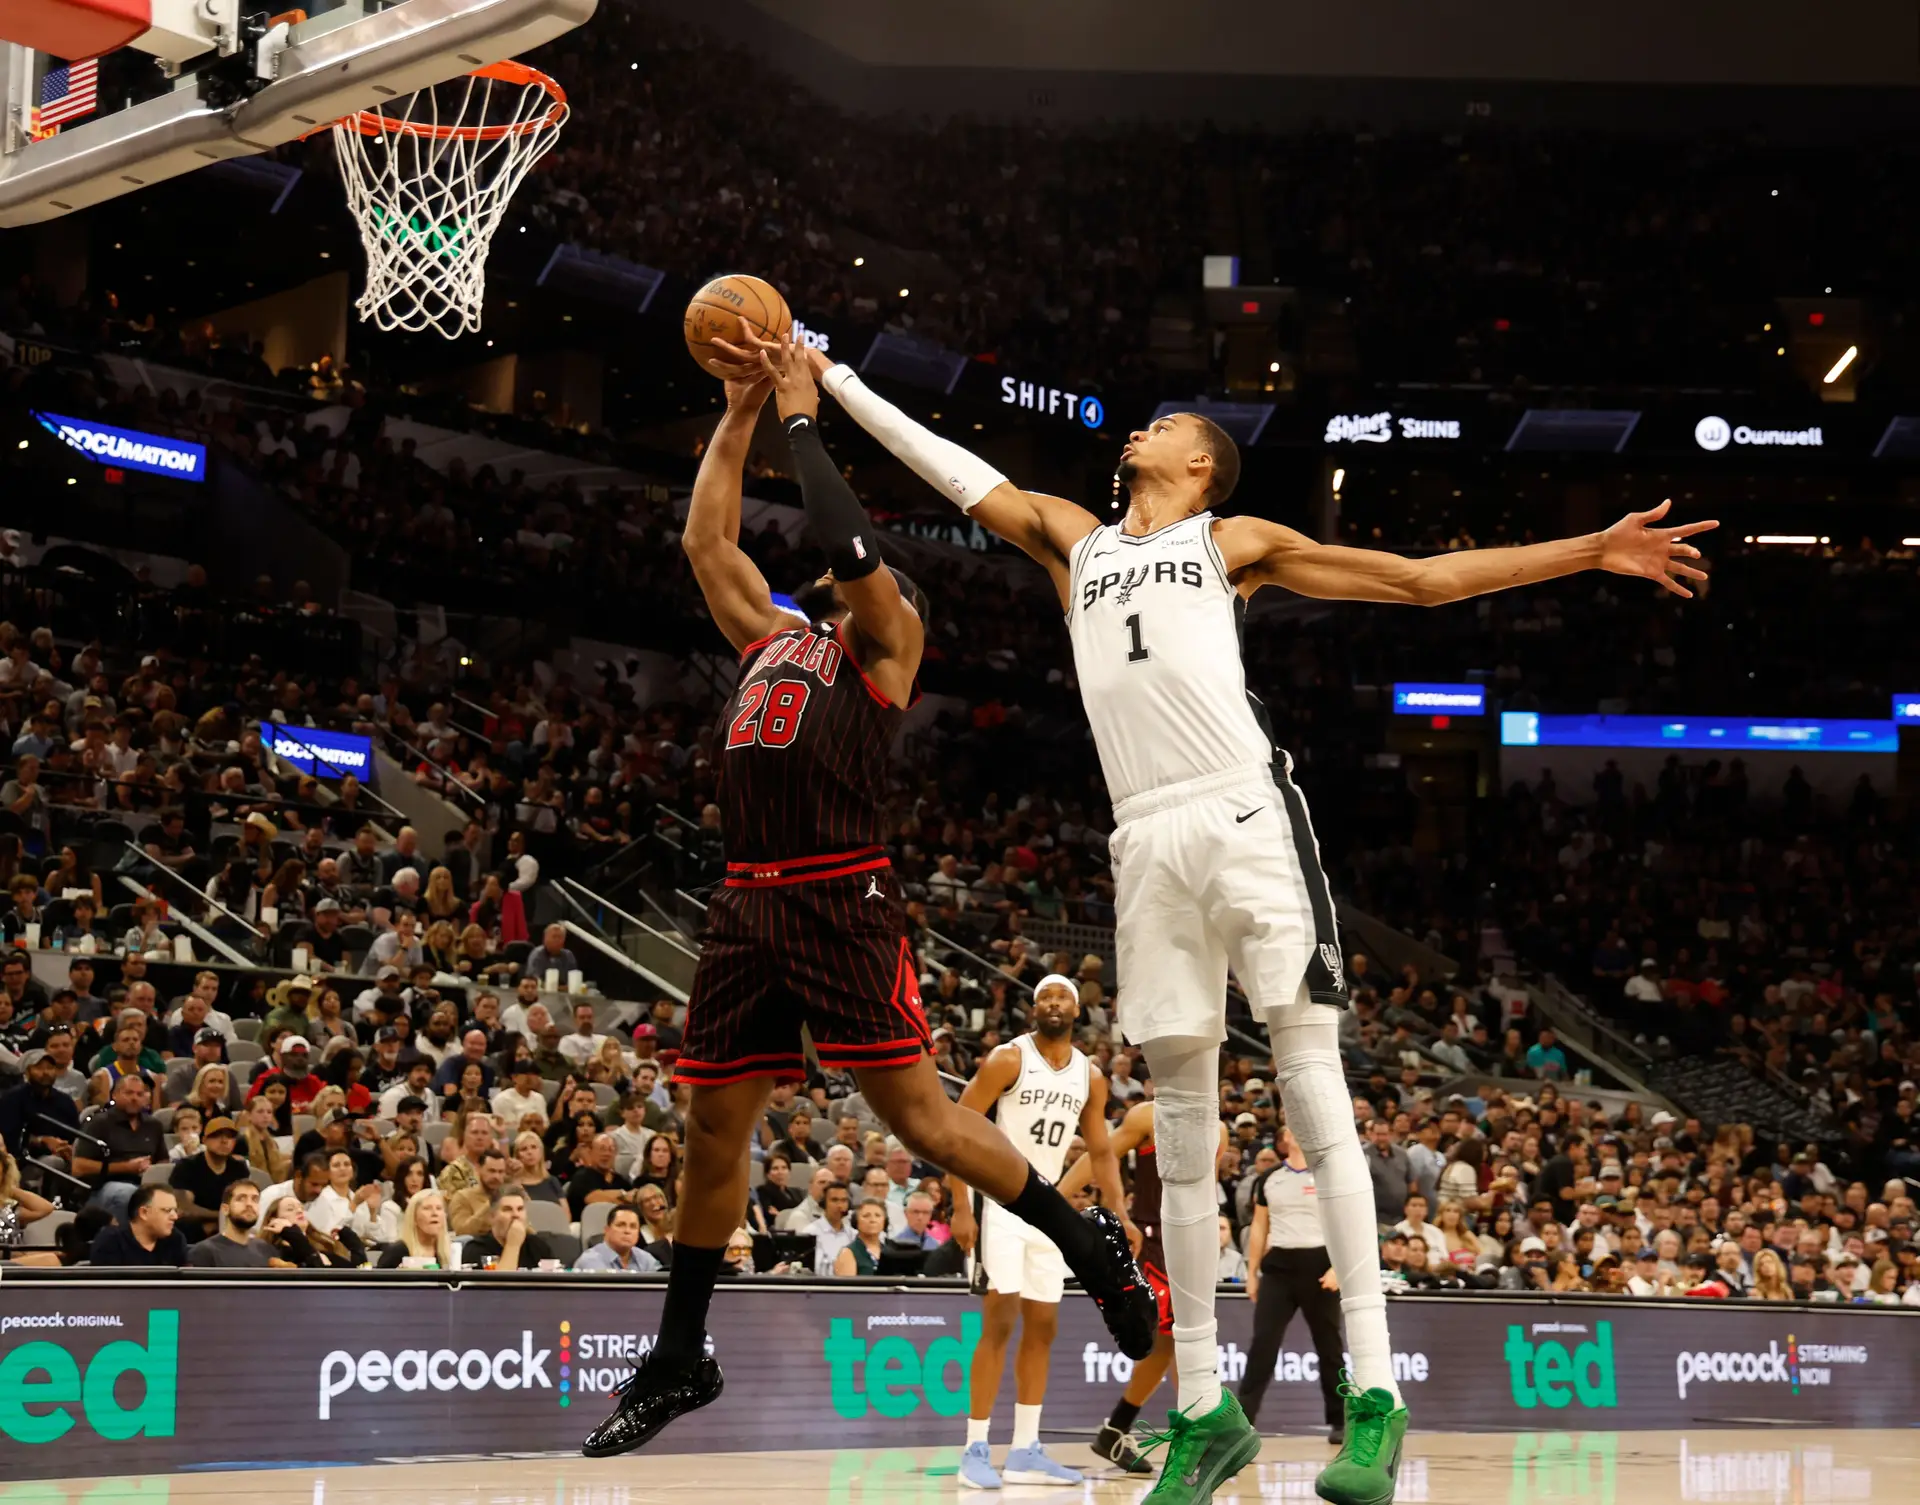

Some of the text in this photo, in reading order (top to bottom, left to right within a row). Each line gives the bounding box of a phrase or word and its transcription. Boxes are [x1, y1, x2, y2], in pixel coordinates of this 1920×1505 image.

[1733, 425, 1824, 446] Ownwell
[1084, 561, 1203, 611] SPURS
[739, 632, 843, 687] HIAGO
[1123, 611, 1150, 667] 1
[725, 678, 811, 750] 28
[1019, 1089, 1083, 1115] SPURS
[1030, 1118, 1066, 1147] 40
[1, 1312, 124, 1334] peacock ORIGINAL
[867, 1312, 909, 1331] peacock
[578, 1334, 715, 1360] STREAG
[824, 1311, 983, 1419] ted
[1082, 1342, 1134, 1383] fro
[1504, 1320, 1618, 1409] ted
[1798, 1345, 1868, 1363] STREAMING
[319, 1330, 553, 1420] peacock
[1677, 1340, 1790, 1400] peacock
[1799, 1368, 1831, 1385] NOW
